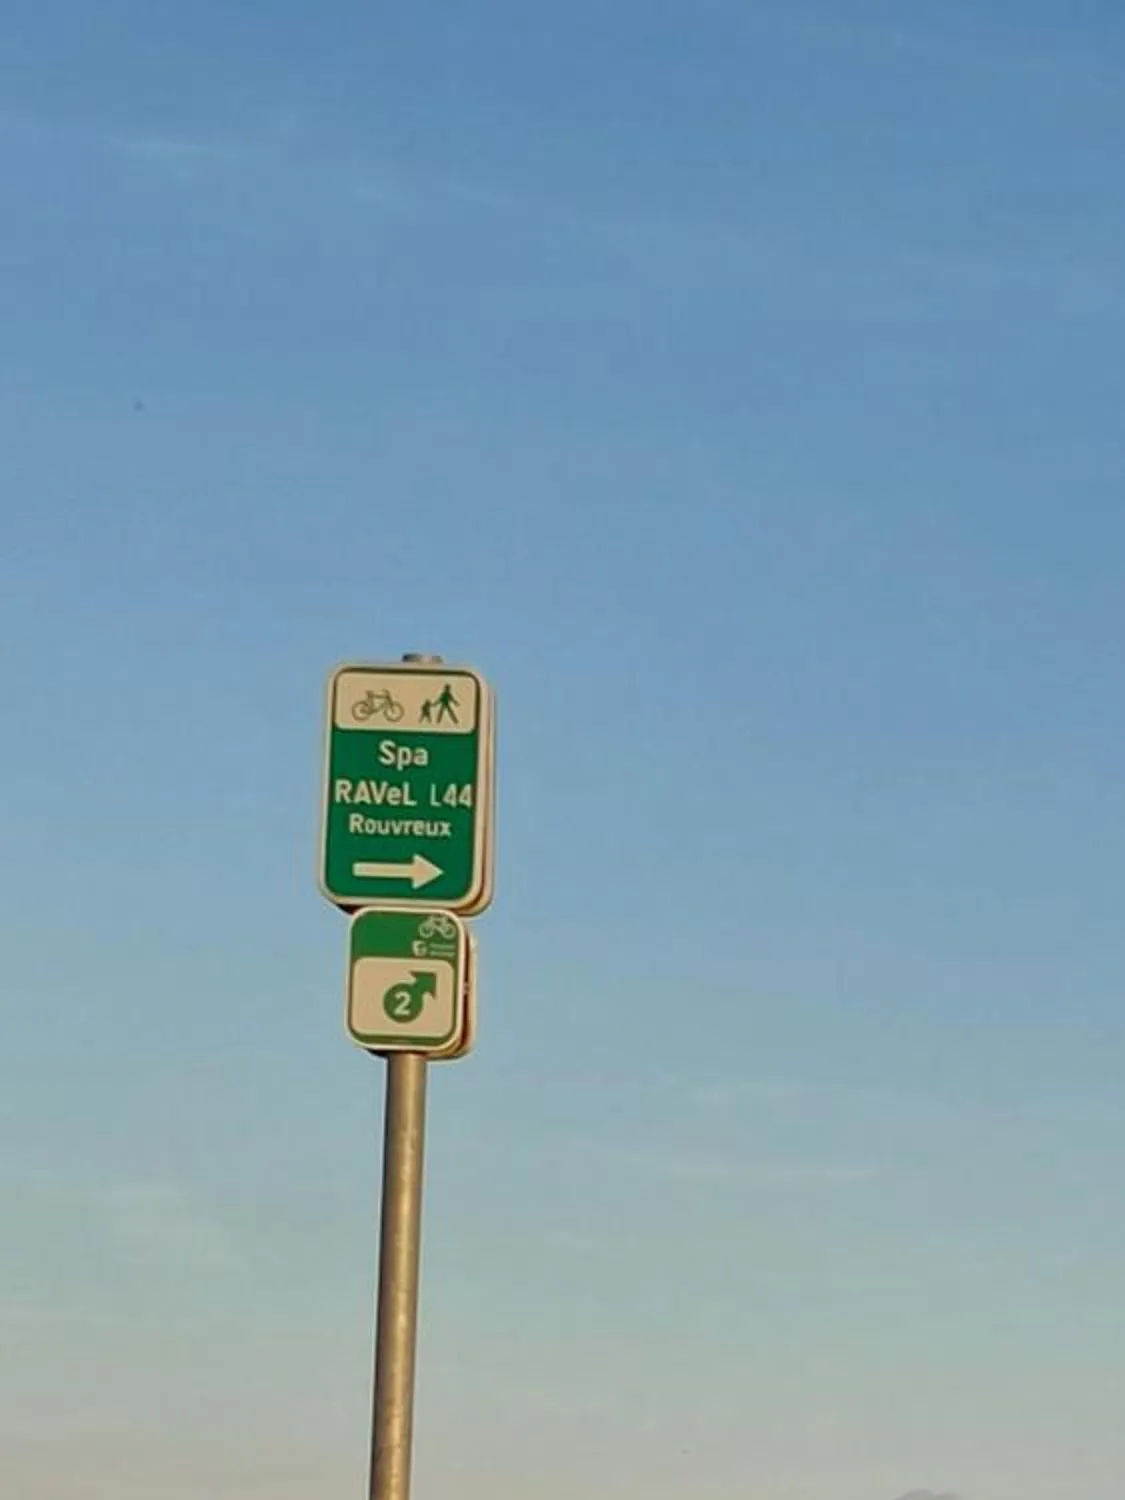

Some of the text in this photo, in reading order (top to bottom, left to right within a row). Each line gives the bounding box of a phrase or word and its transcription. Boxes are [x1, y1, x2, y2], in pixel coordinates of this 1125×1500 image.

[378, 740, 428, 771] Spa
[334, 779, 473, 808] RAVeL L44
[350, 813, 451, 836] Rouvreux
[394, 991, 411, 1015] 2
